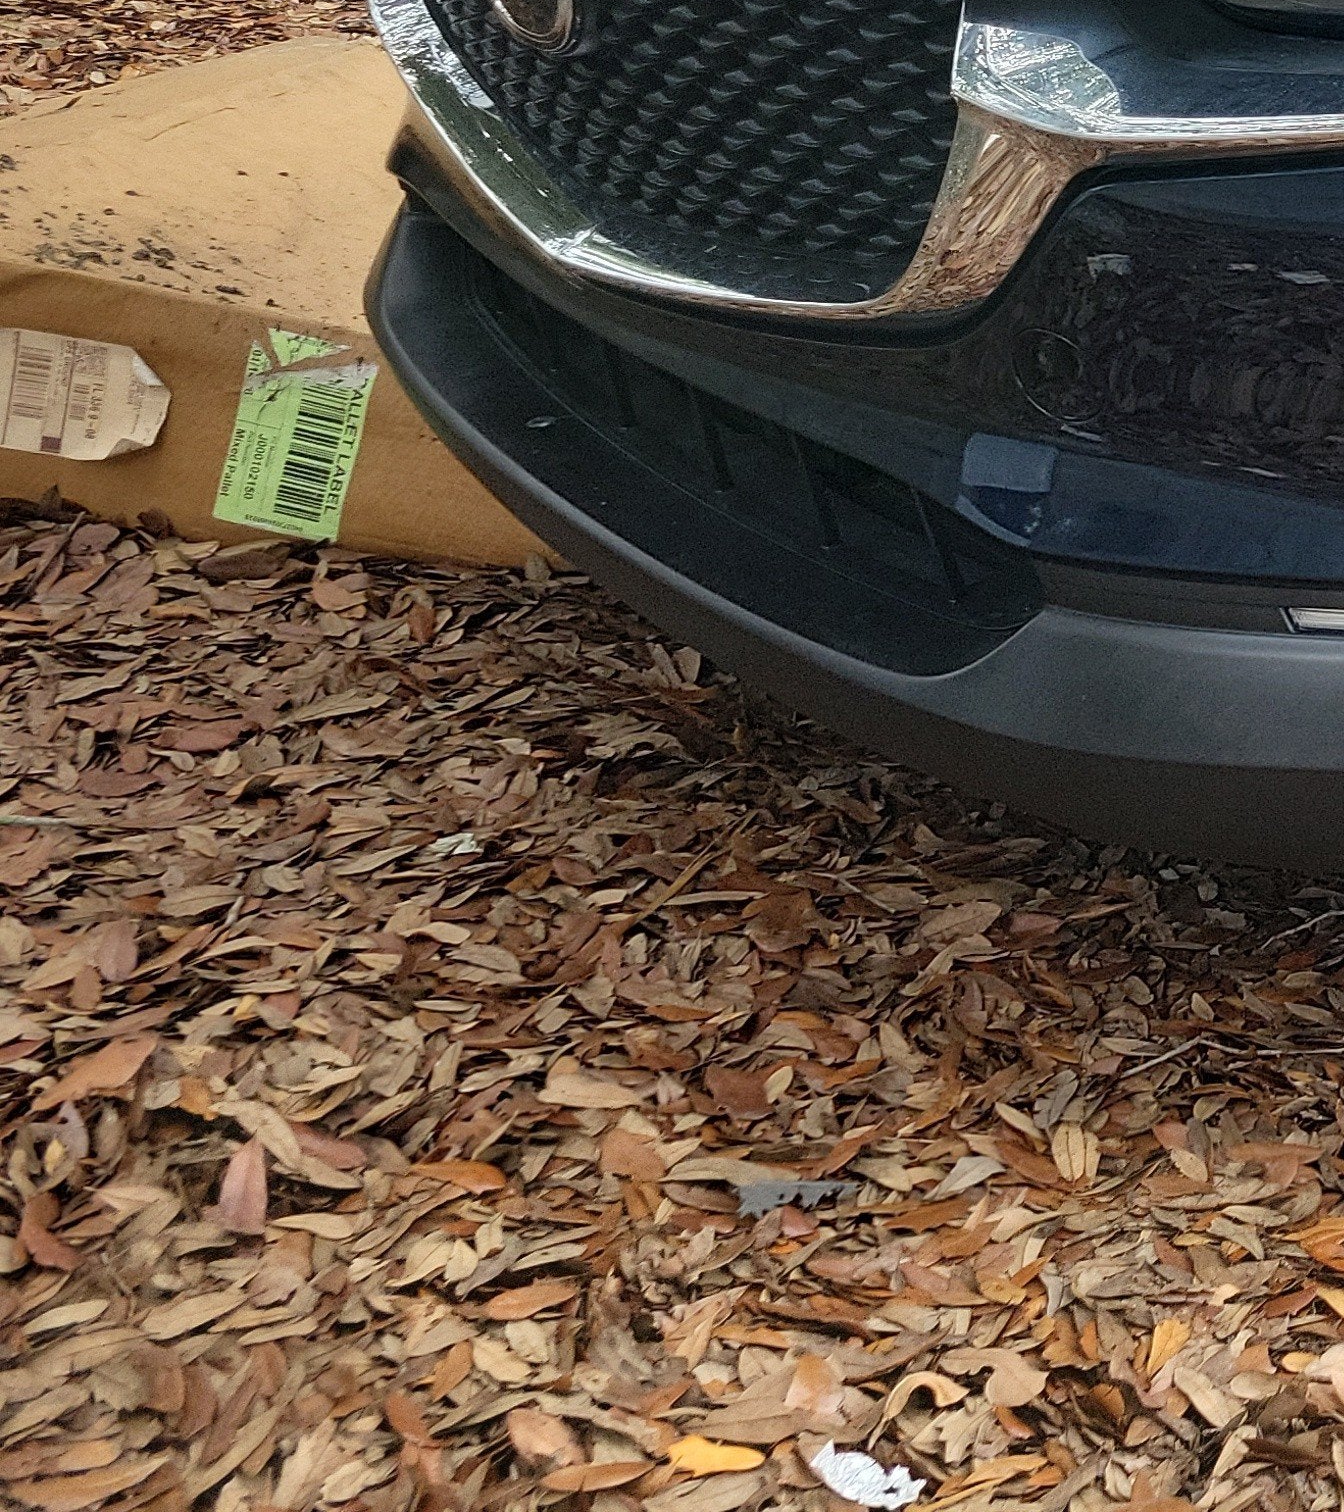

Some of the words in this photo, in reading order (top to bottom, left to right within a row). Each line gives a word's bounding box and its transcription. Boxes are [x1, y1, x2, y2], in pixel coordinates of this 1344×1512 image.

[227, 428, 246, 462] Mixed
[219, 461, 237, 497] Pallet
[323, 453, 352, 516] LABEL
